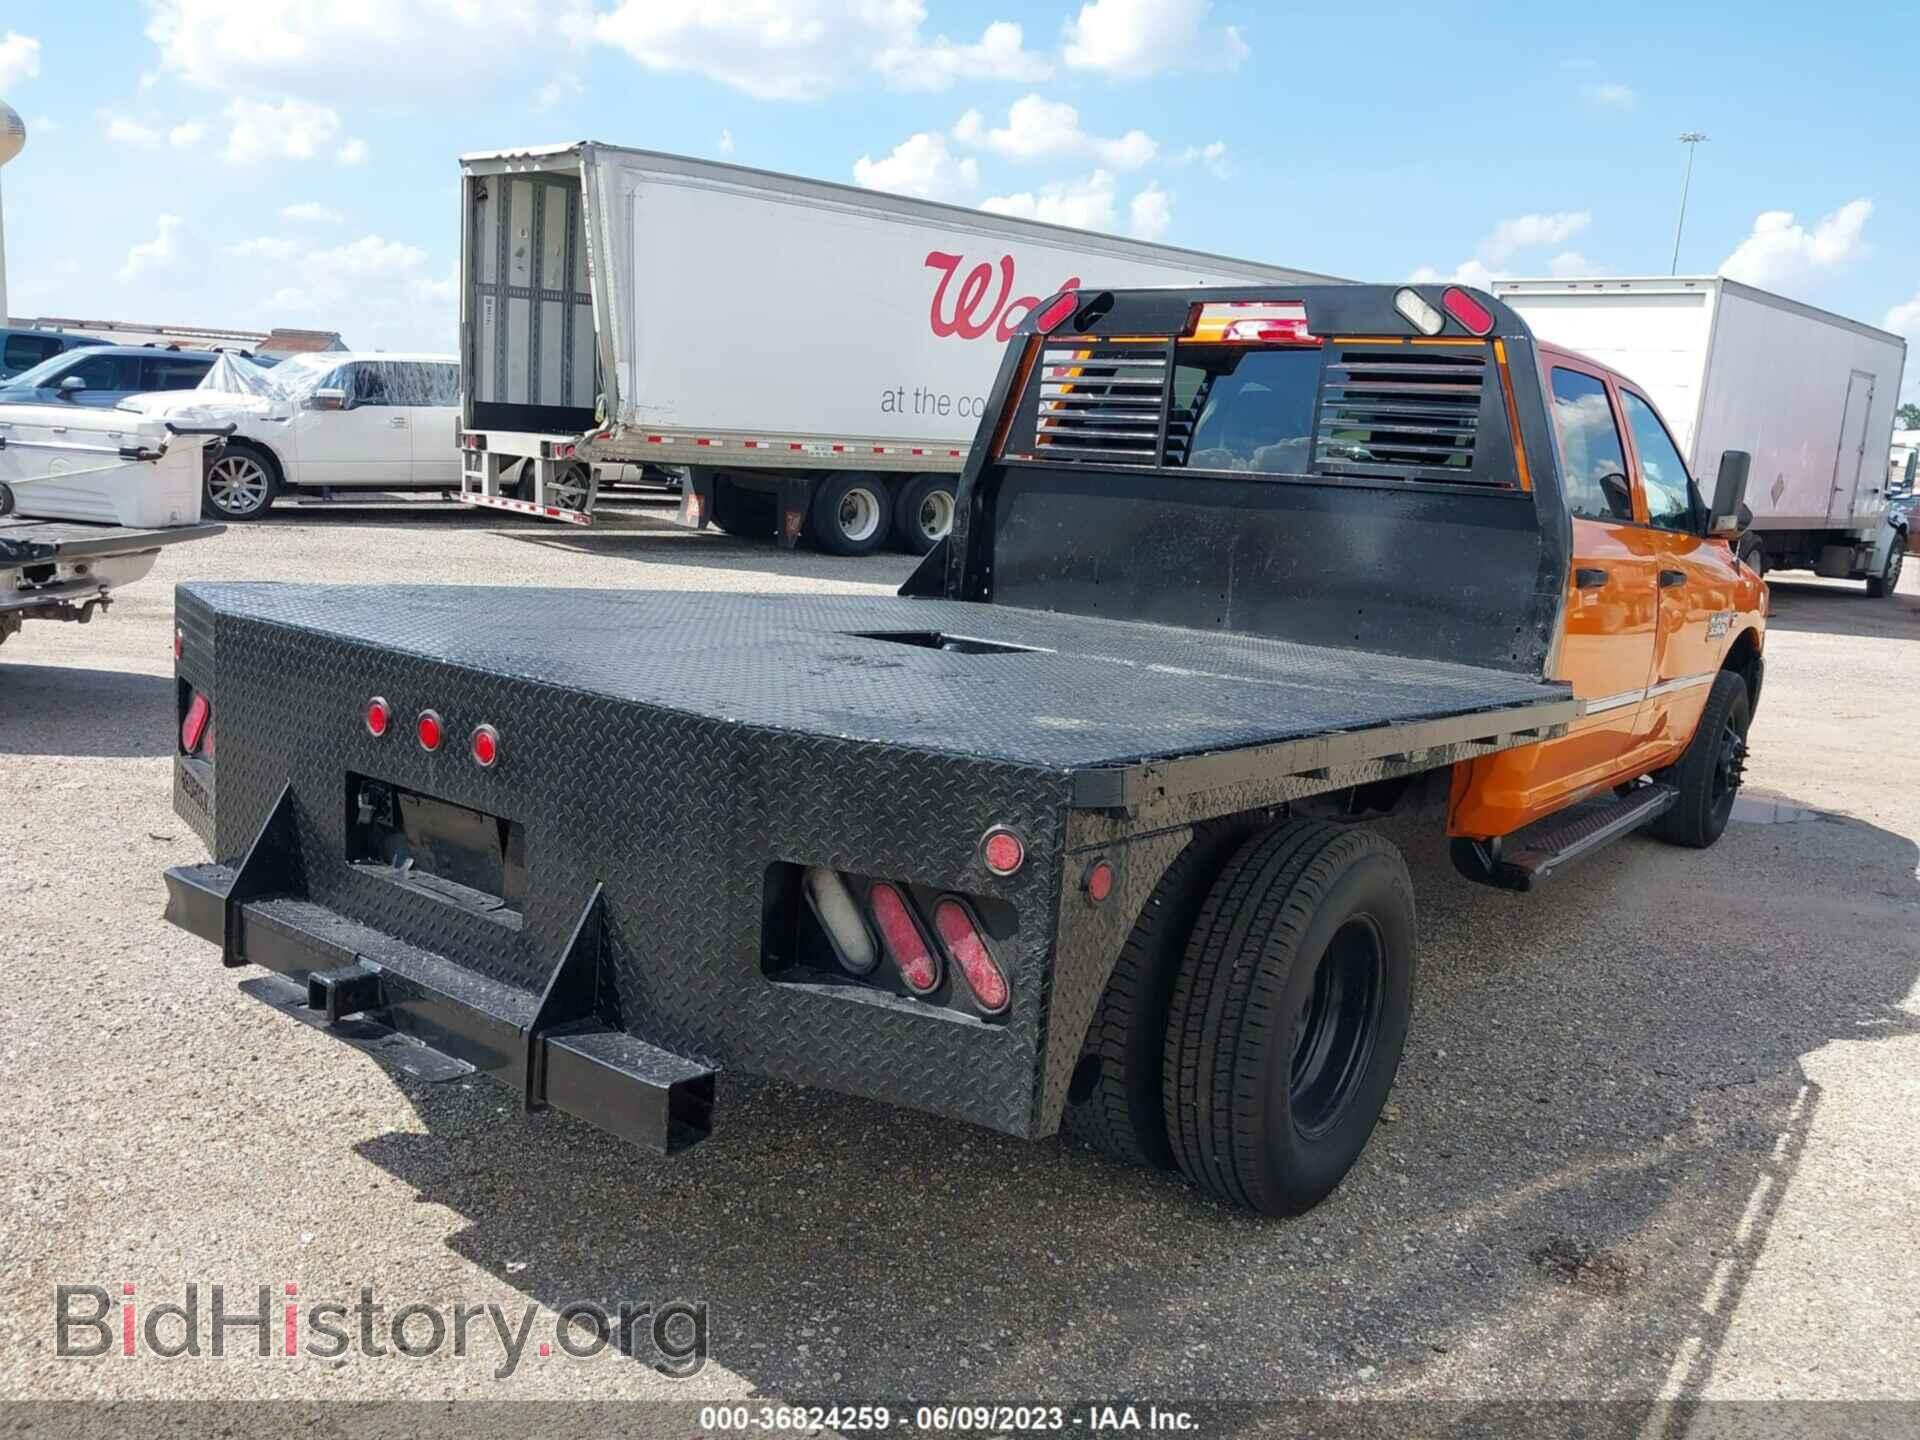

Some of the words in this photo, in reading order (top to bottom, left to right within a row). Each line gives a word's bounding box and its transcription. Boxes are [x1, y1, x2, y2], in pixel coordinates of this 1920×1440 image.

[924, 250, 1081, 343] Wa
[881, 386, 905, 414] at
[913, 386, 951, 416] the
[958, 395, 988, 418] co
